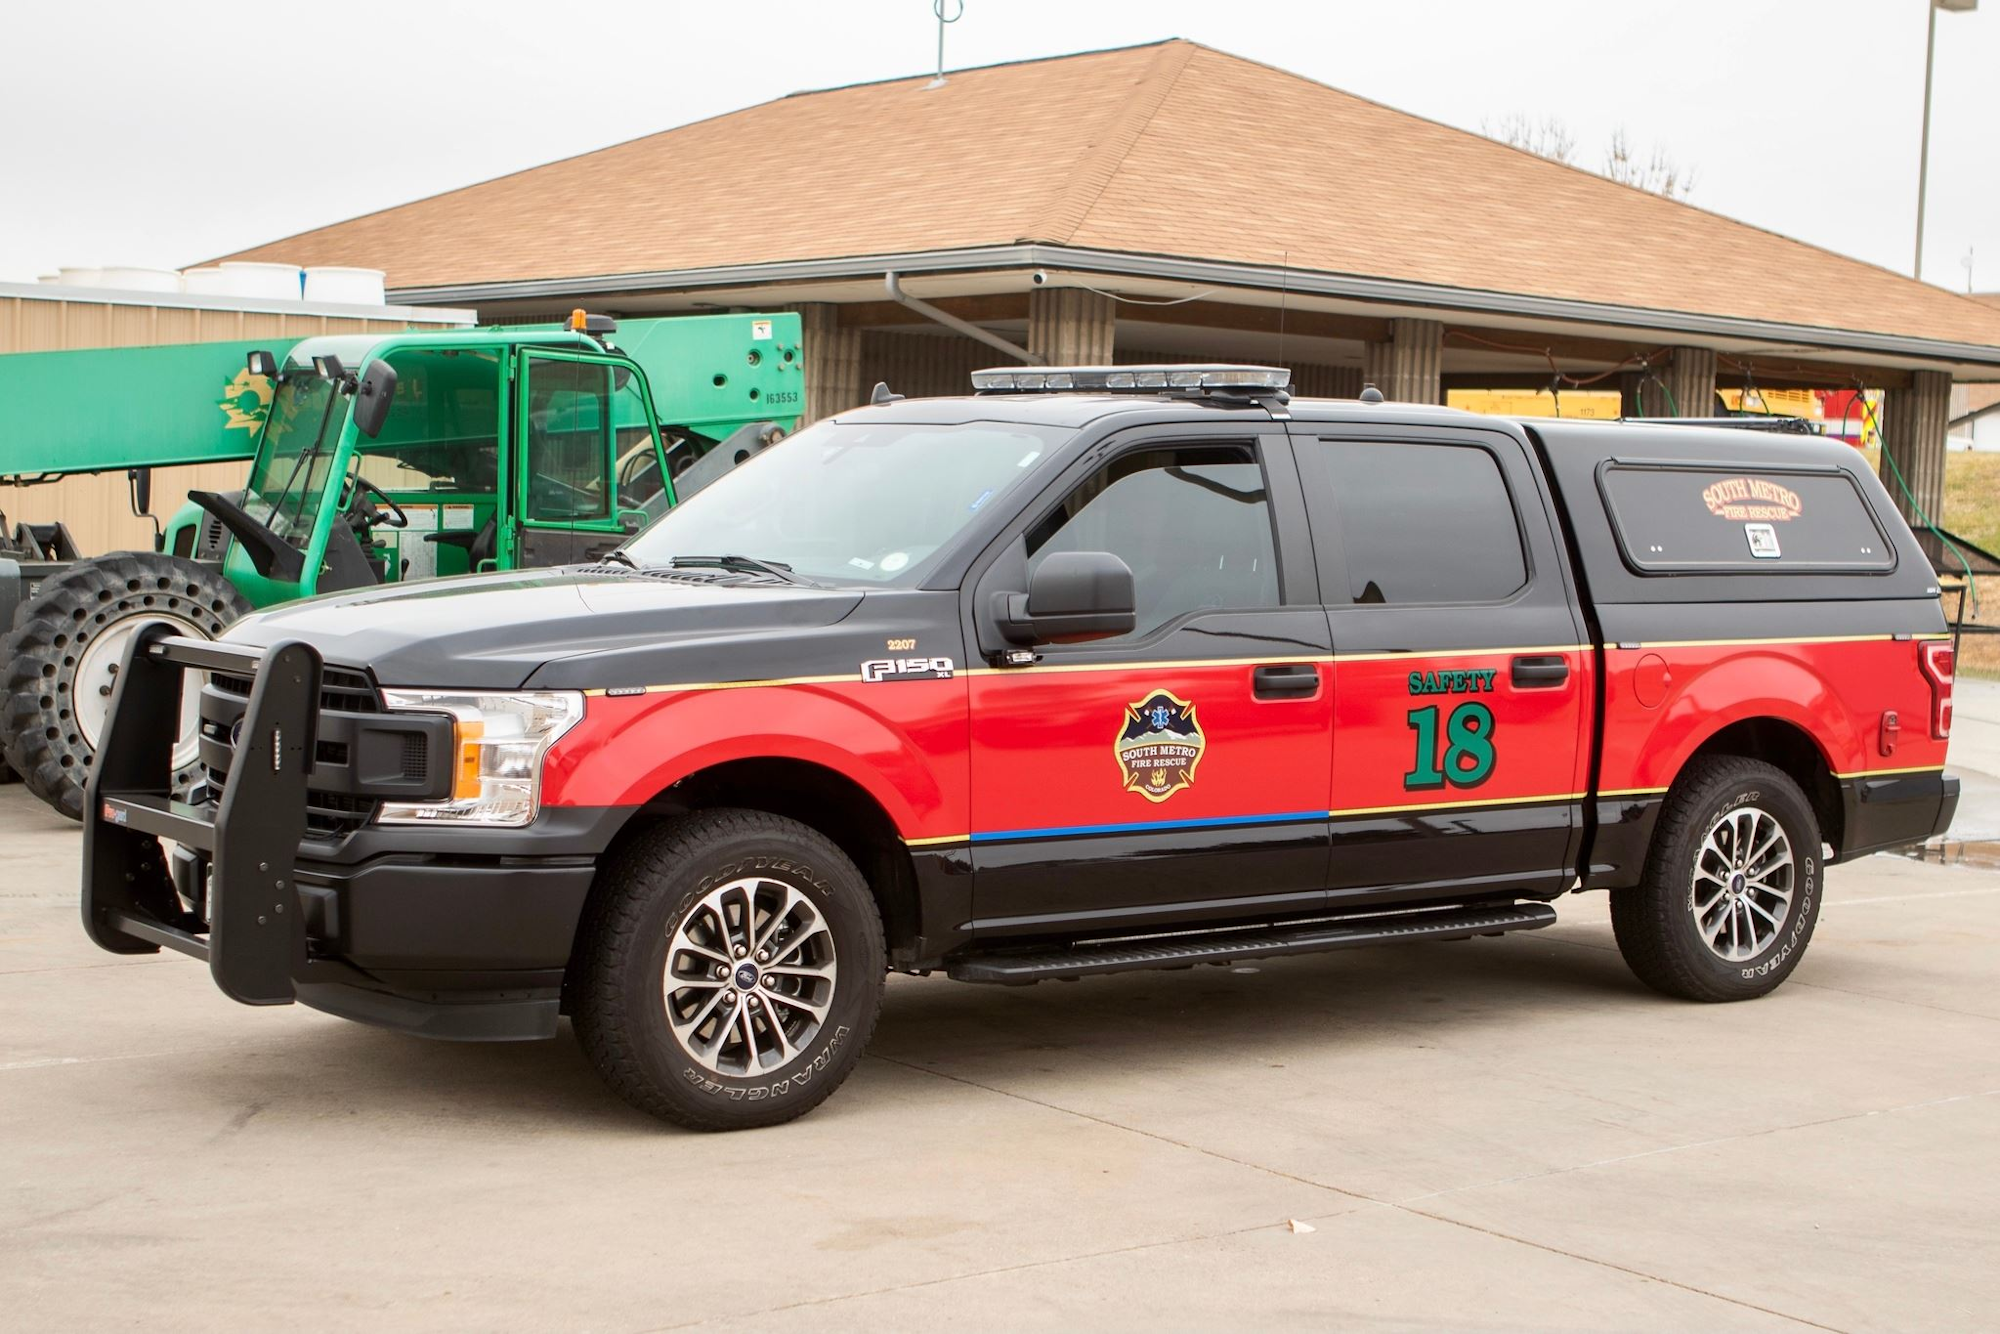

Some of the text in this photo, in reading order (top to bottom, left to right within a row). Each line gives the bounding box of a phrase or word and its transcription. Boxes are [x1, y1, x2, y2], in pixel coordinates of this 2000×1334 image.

[766, 392, 798, 404] 163553
[1703, 478, 1802, 513] SOUTH METRO
[1723, 505, 1790, 520] FIRE RESCUE
[887, 639, 916, 650] 2207
[1408, 668, 1496, 695] SAFETY
[1122, 746, 1196, 761] SOUTH METRO
[1404, 701, 1497, 792] 18
[1131, 758, 1187, 768] FIRE RESCUE
[1742, 857, 1814, 978] GOODYEAR
[683, 1025, 850, 1100] WRANGLER
